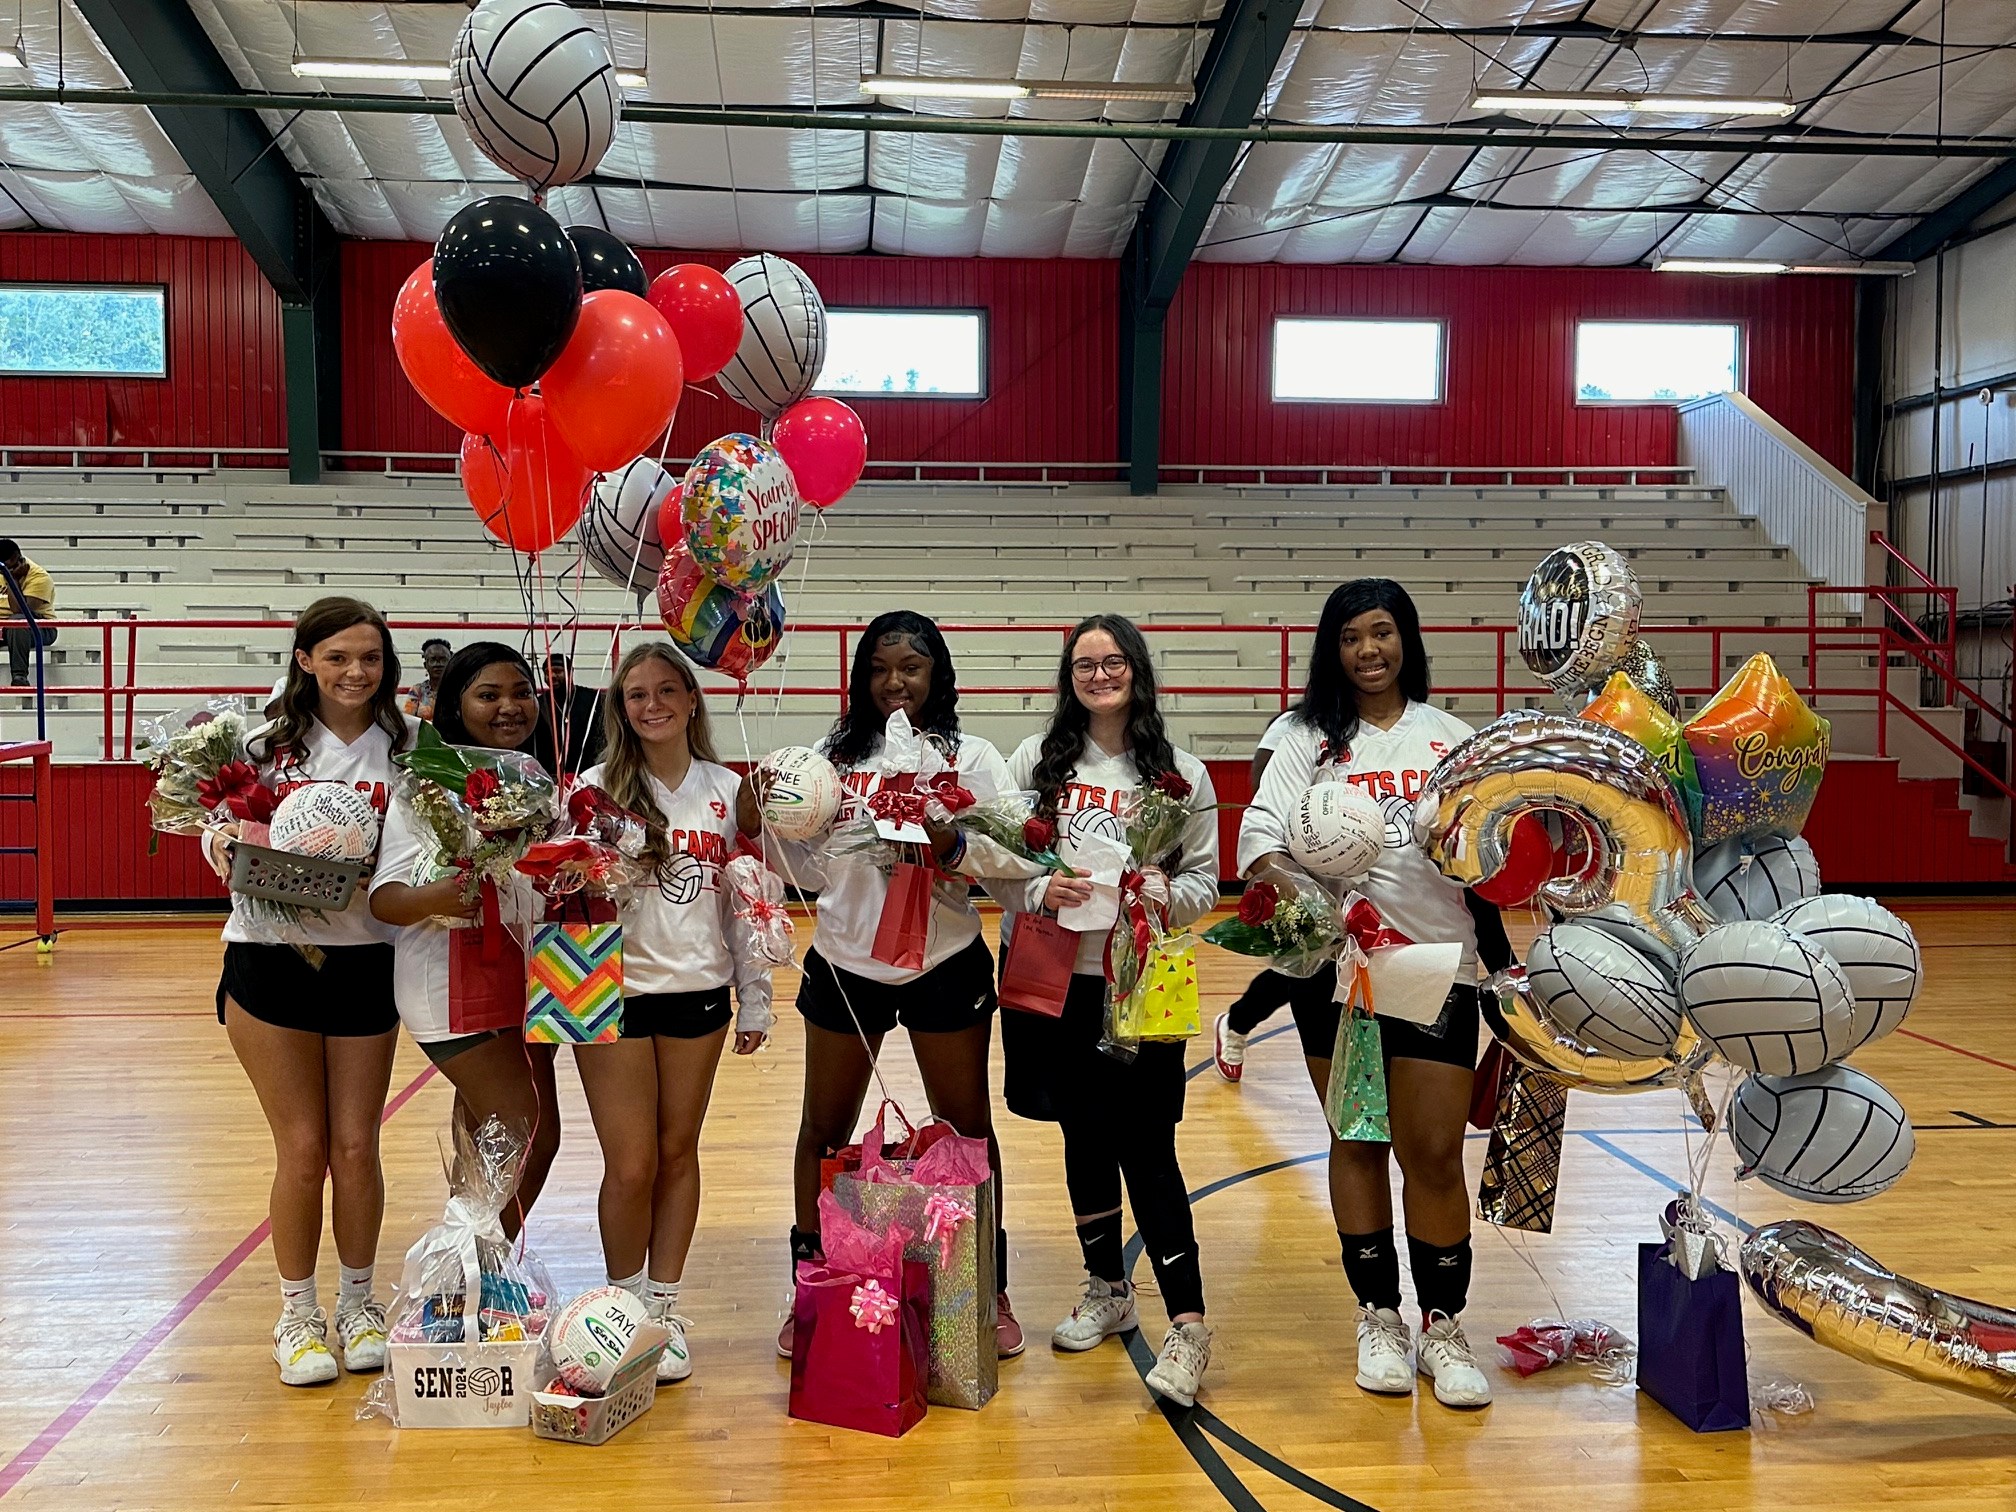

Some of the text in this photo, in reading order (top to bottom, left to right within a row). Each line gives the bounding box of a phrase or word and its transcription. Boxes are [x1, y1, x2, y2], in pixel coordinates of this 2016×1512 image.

[747, 476, 787, 515] You're
[752, 497, 799, 551] SPECIA
[1581, 546, 1612, 586] GRD
[1578, 613, 1610, 660] BEGN
[776, 770, 802, 785] NEE
[1347, 769, 1397, 803] TTS
[1061, 782, 1107, 810] TTS
[1300, 788, 1313, 834] SMASH
[605, 1306, 636, 1339] JAYL
[456, 1367, 466, 1398] 2024
[483, 1397, 513, 1416] Jaylee
